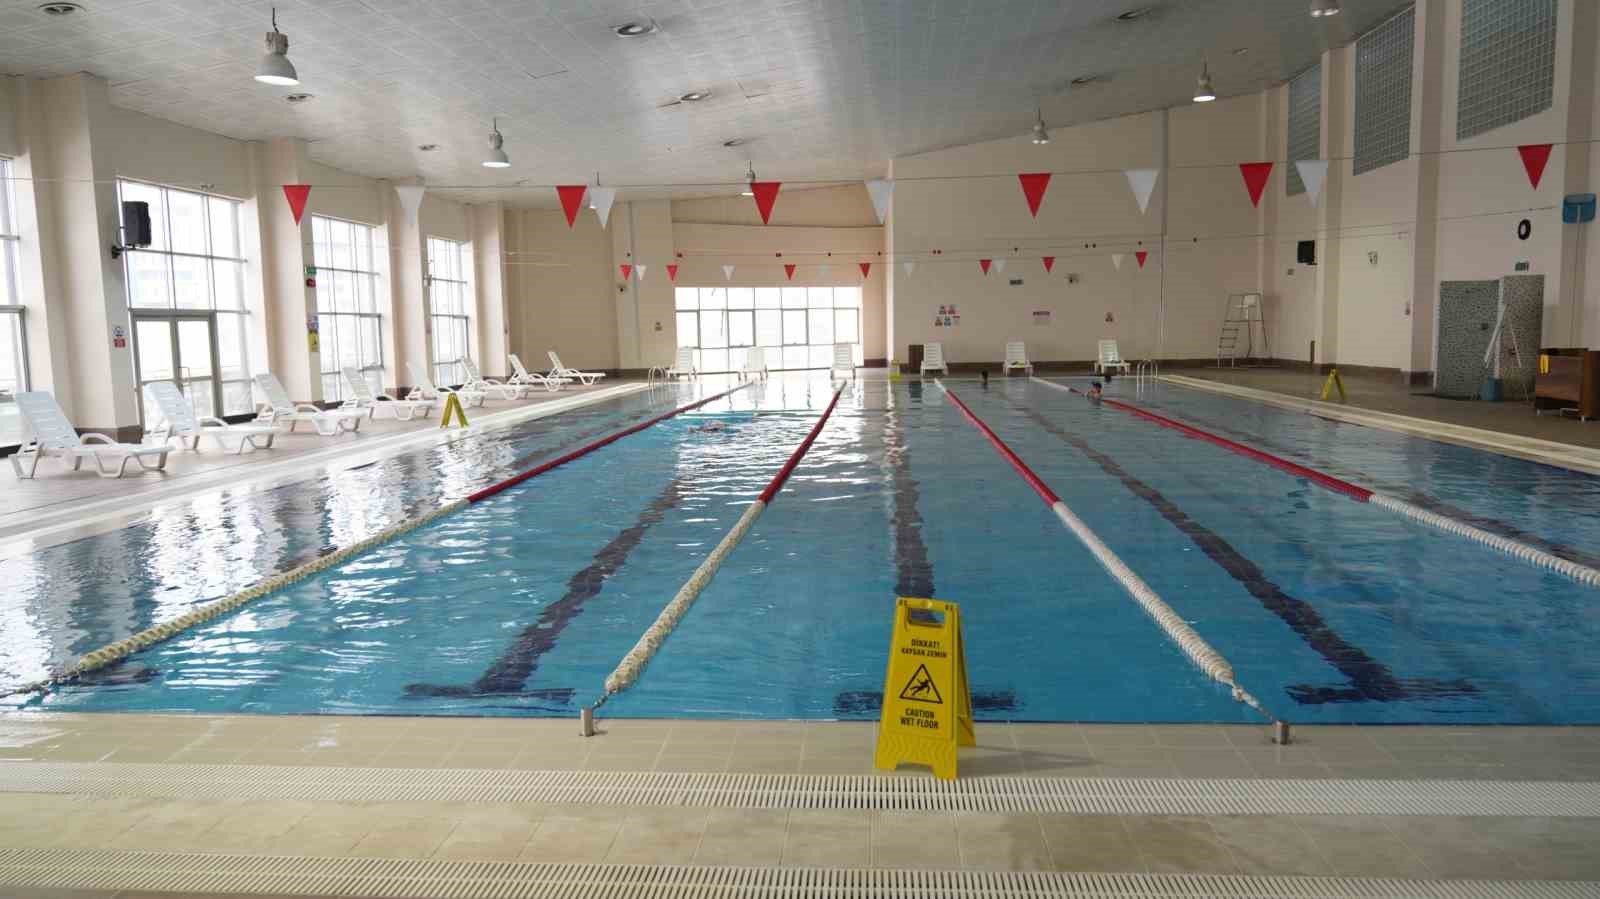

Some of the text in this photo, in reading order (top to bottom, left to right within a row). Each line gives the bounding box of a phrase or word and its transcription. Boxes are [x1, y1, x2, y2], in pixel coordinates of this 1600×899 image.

[905, 708, 935, 719] CAUTION
[900, 717, 939, 729] WET FLOOR
